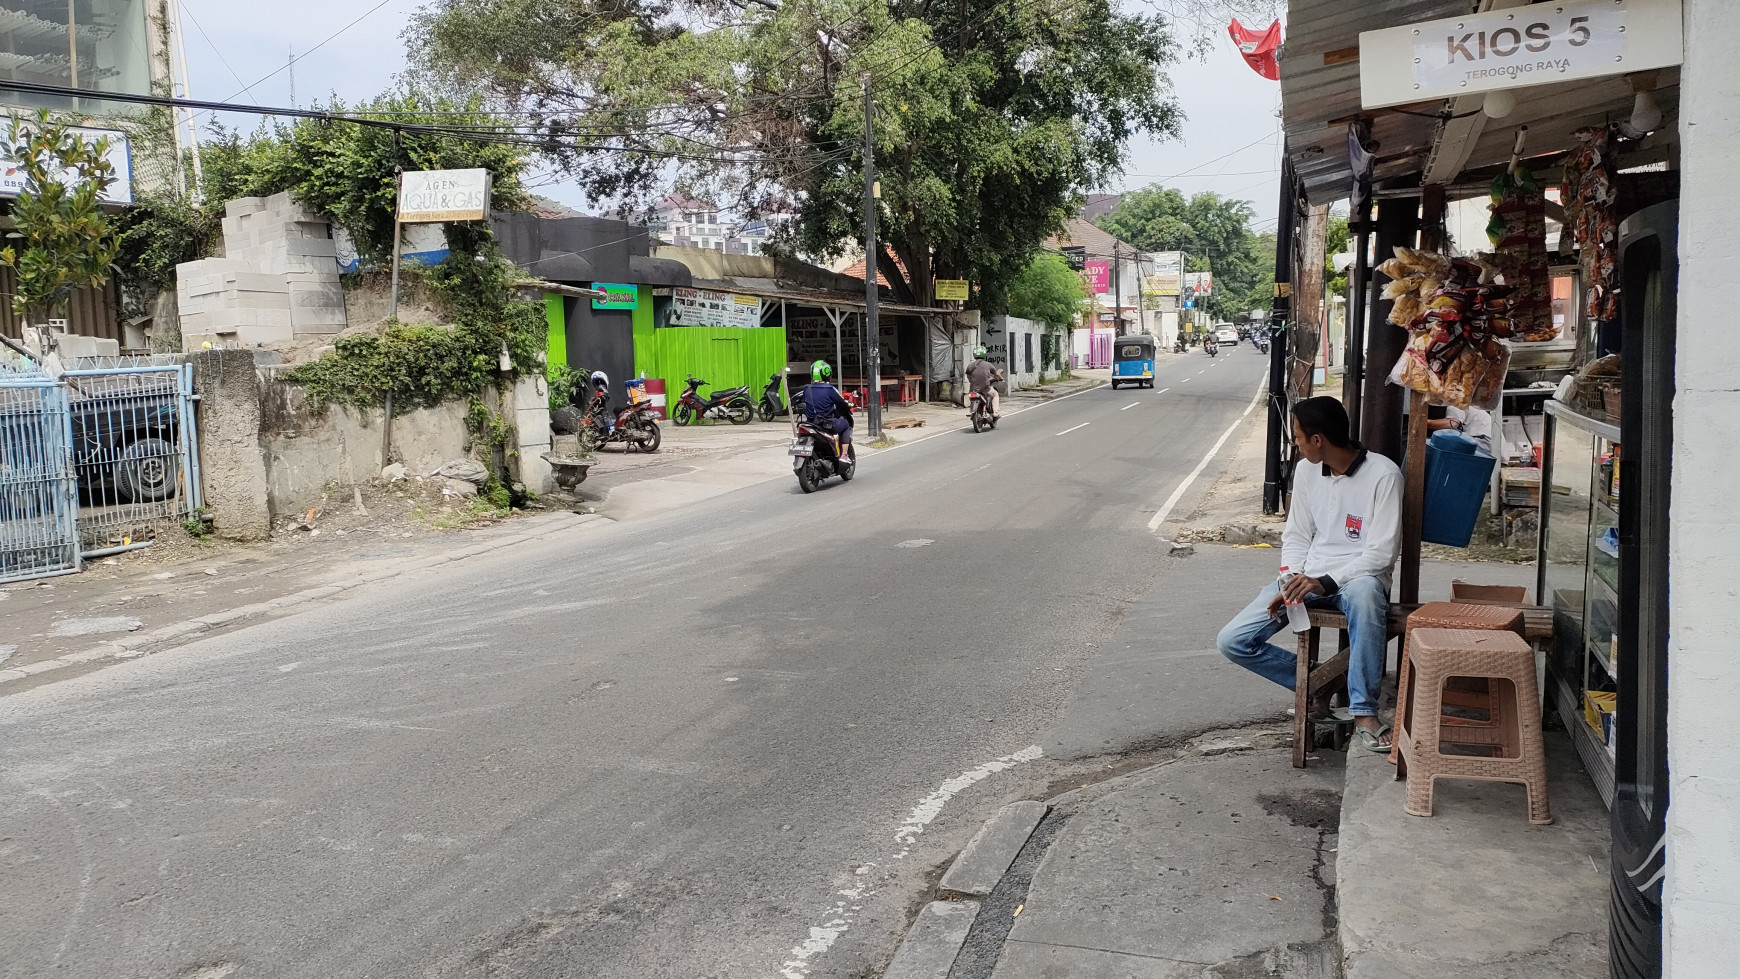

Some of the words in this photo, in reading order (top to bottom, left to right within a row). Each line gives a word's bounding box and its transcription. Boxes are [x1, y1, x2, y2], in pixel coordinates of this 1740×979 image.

[1447, 22, 1551, 64] KIOS
[1568, 16, 1591, 47] 5
[1465, 63, 1533, 80] TEROGONG
[1536, 58, 1571, 71] RAYA
[425, 180, 456, 191] AGEN
[402, 191, 439, 210] AQUA
[440, 193, 450, 209] &
[453, 190, 483, 208] GAS
